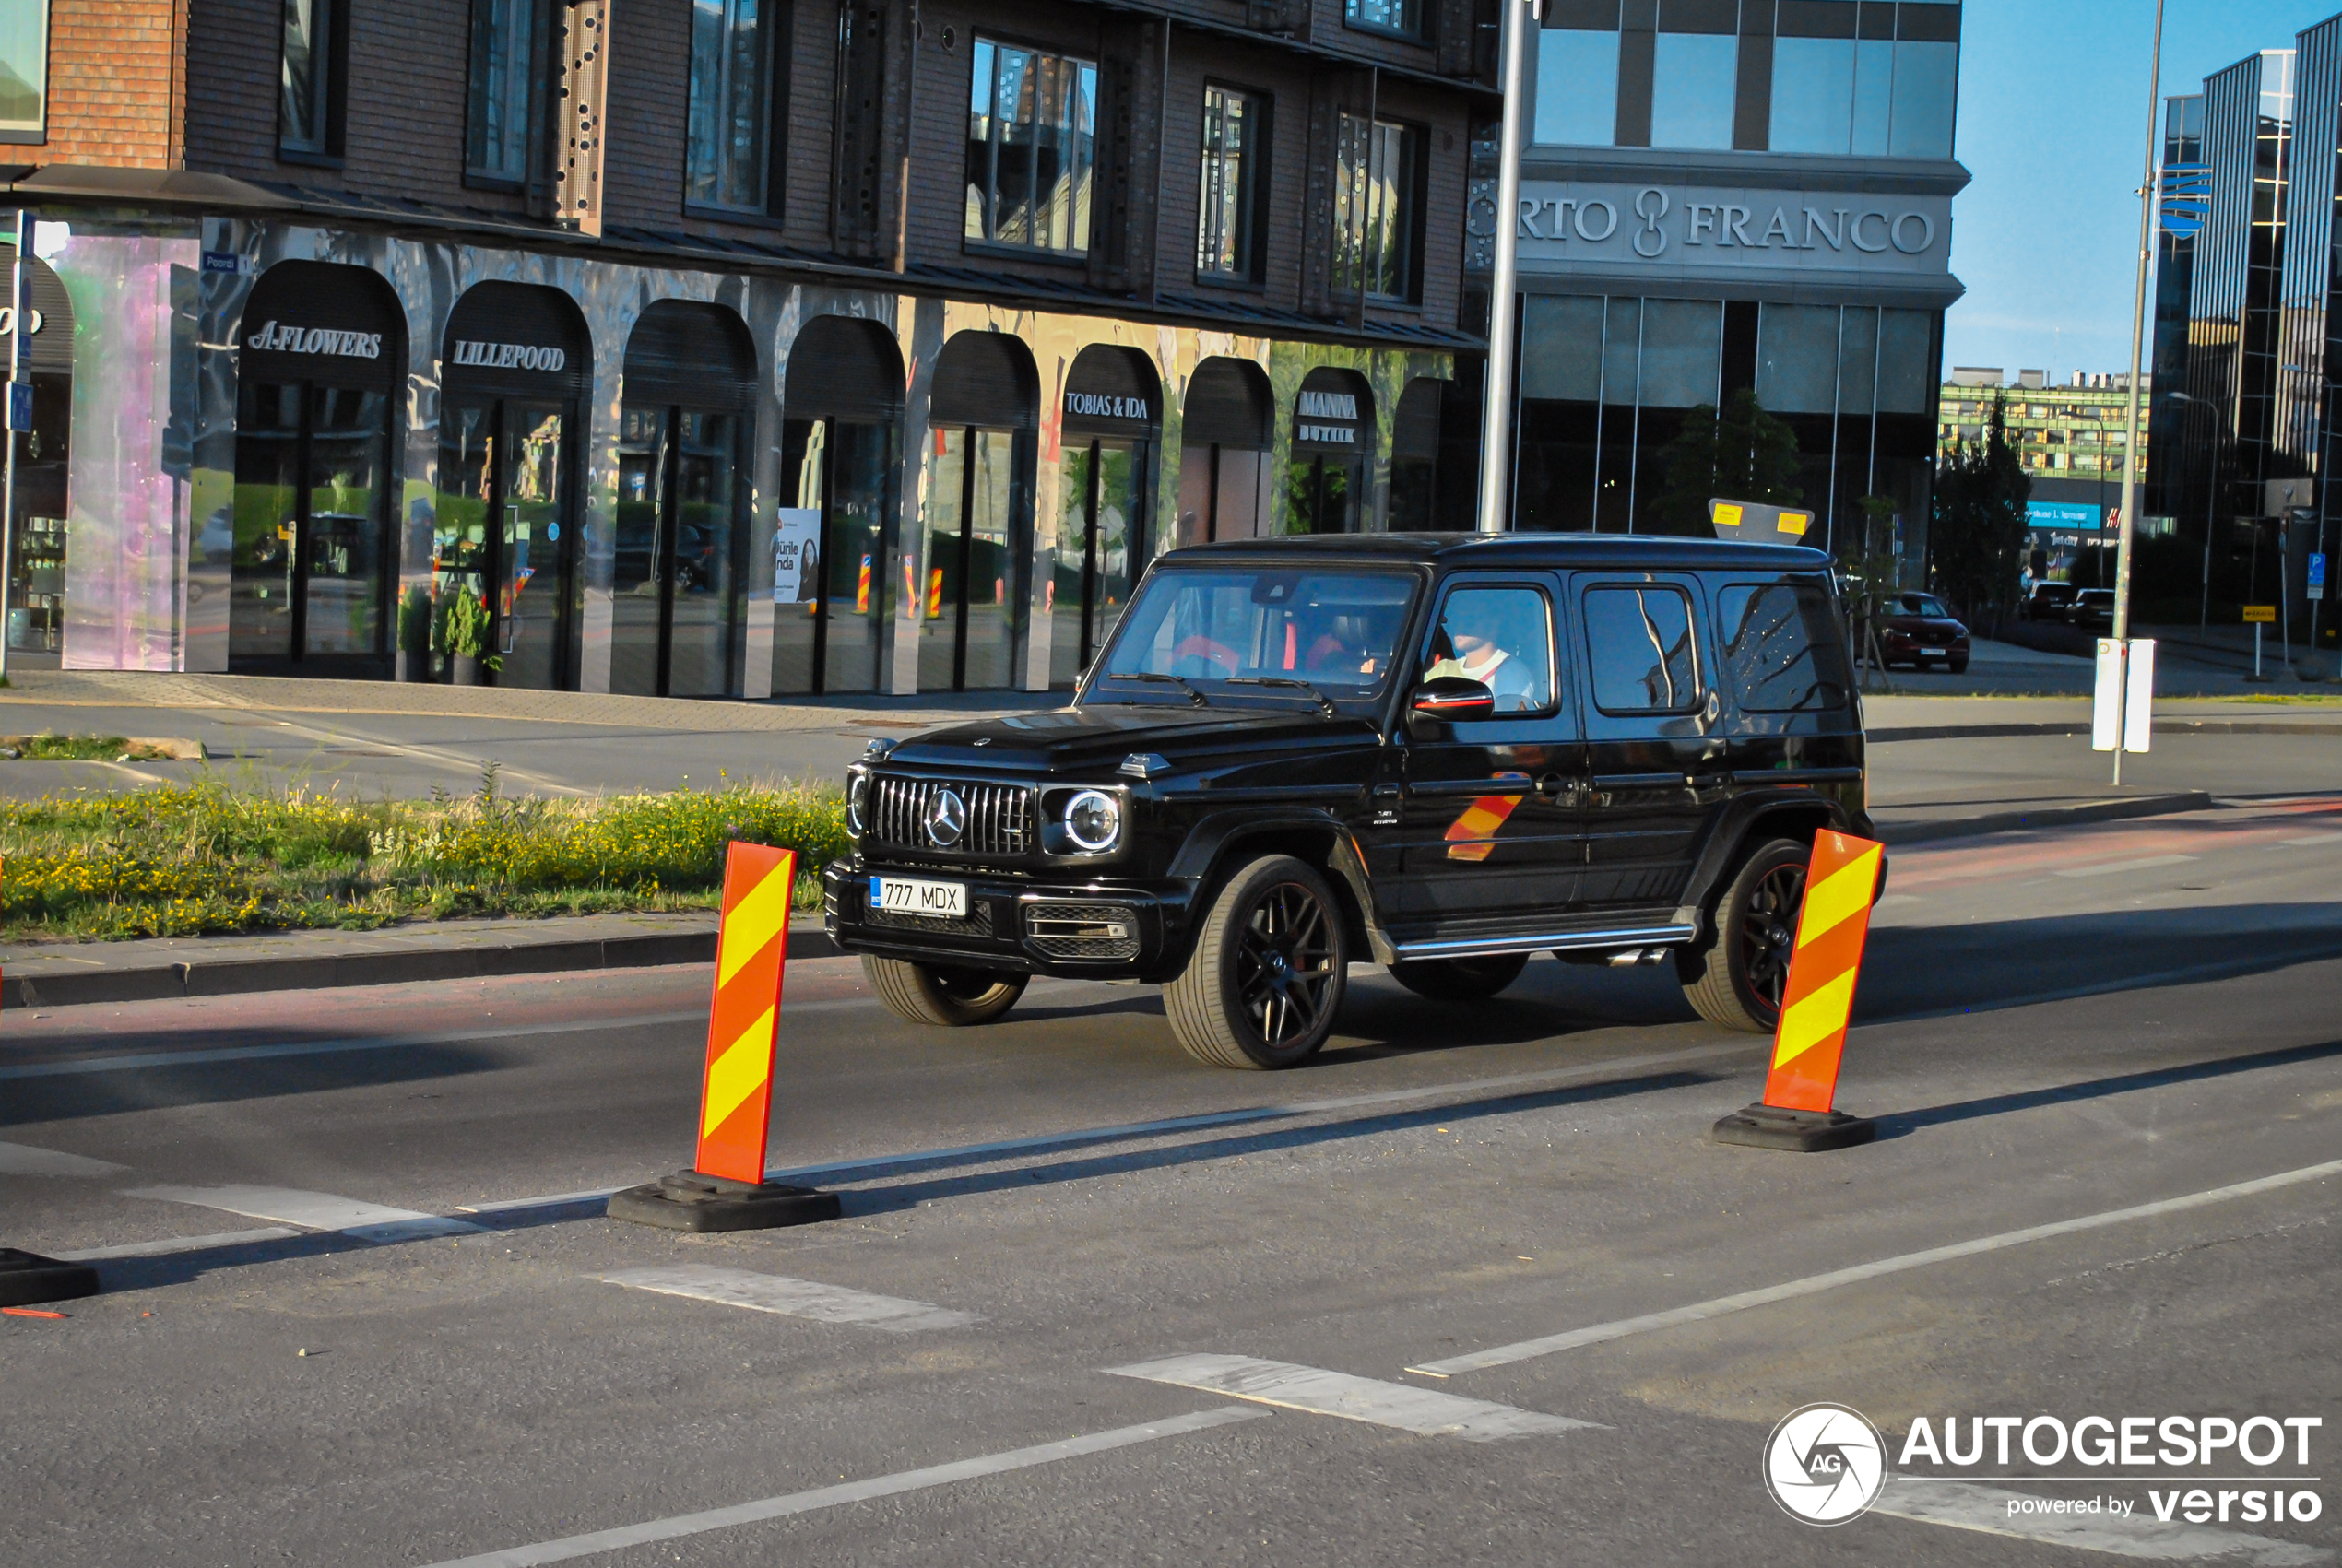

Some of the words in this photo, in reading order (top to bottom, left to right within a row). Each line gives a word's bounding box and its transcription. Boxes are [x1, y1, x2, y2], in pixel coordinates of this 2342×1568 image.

[1466, 198, 1618, 242] ORTO
[1685, 204, 1935, 254] FRANCO
[243, 259, 248, 270] 1
[247, 320, 382, 359] A-FLOWERS
[453, 339, 565, 371] LILLEPOOD
[1067, 392, 1111, 417] TOBIAS
[1113, 396, 1123, 418] &
[1125, 397, 1148, 419] IDA
[1297, 391, 1358, 419] MANNA
[776, 541, 798, 555] ürile
[776, 556, 794, 571] nda
[2312, 556, 2321, 568] P
[885, 883, 913, 906] 777
[922, 886, 957, 910] MDX
